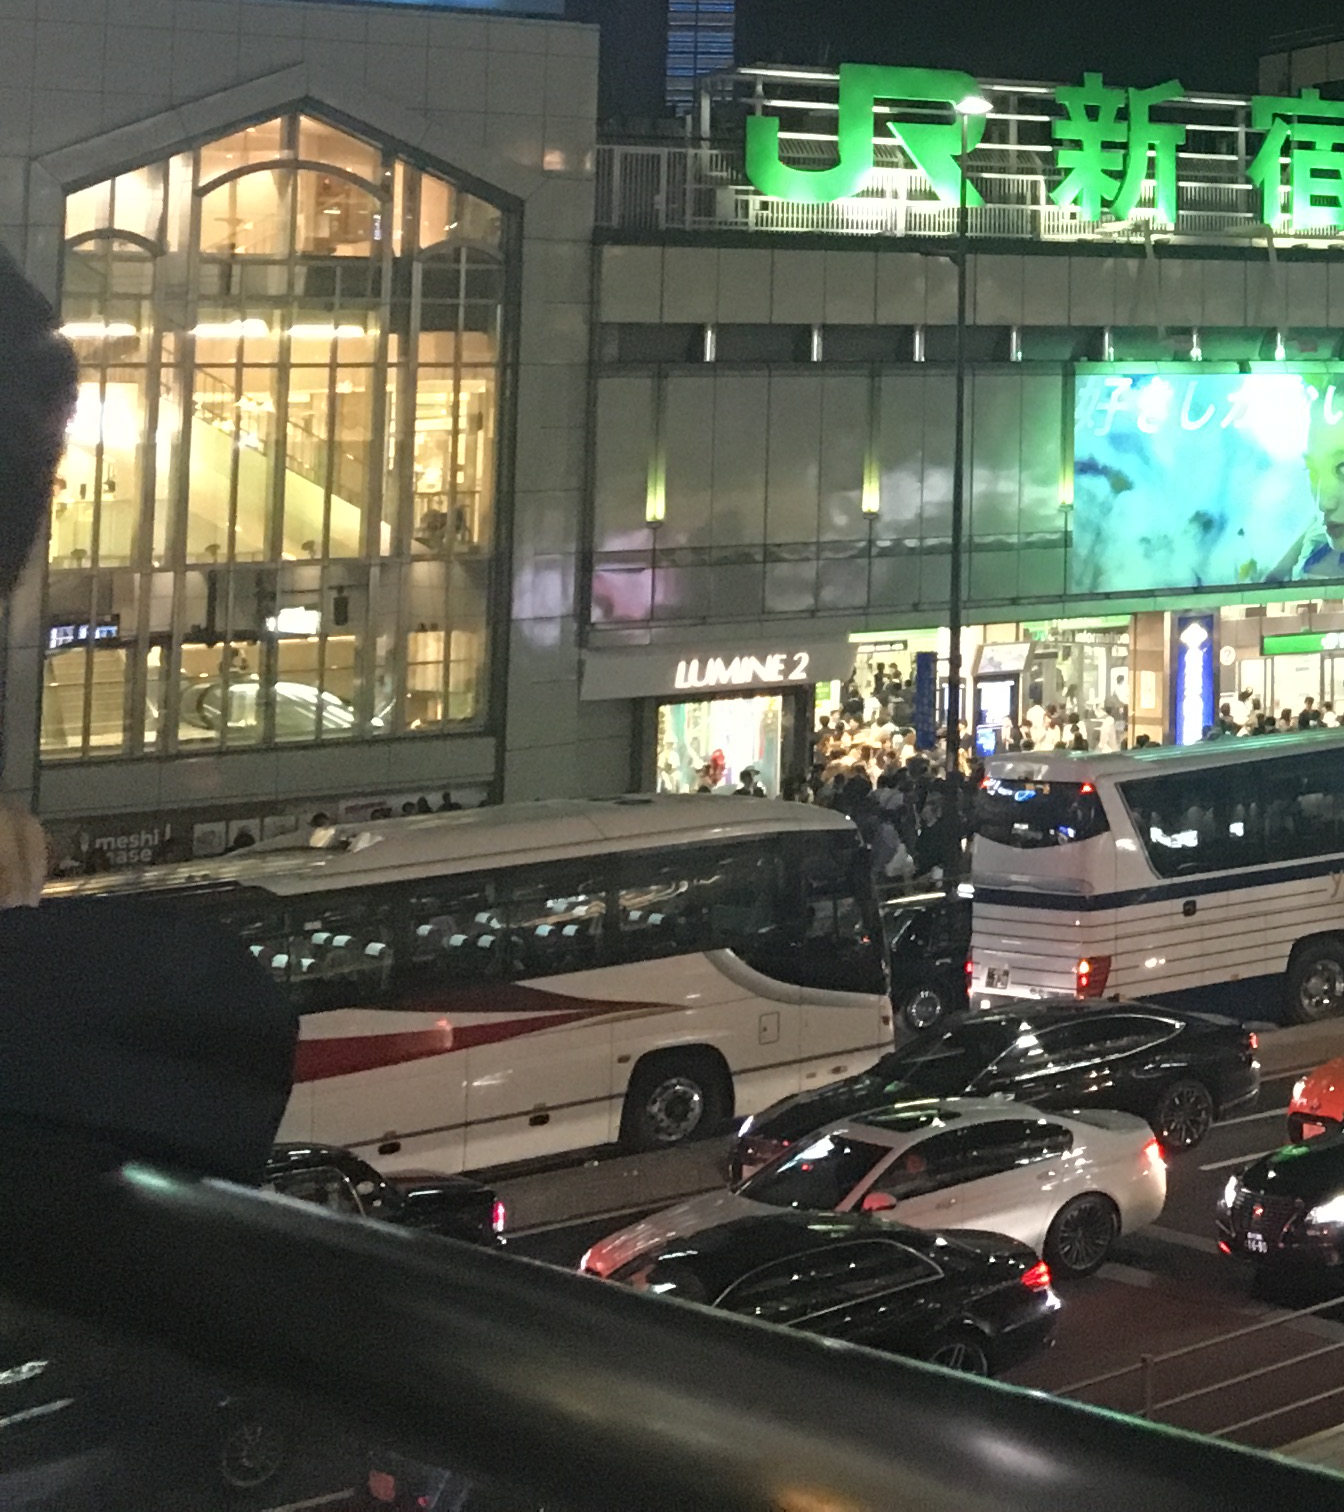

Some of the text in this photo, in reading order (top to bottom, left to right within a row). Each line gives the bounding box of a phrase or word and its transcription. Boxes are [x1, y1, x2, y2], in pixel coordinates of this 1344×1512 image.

[675, 652, 810, 689] LUMINE 2
[95, 828, 160, 851] meshi
